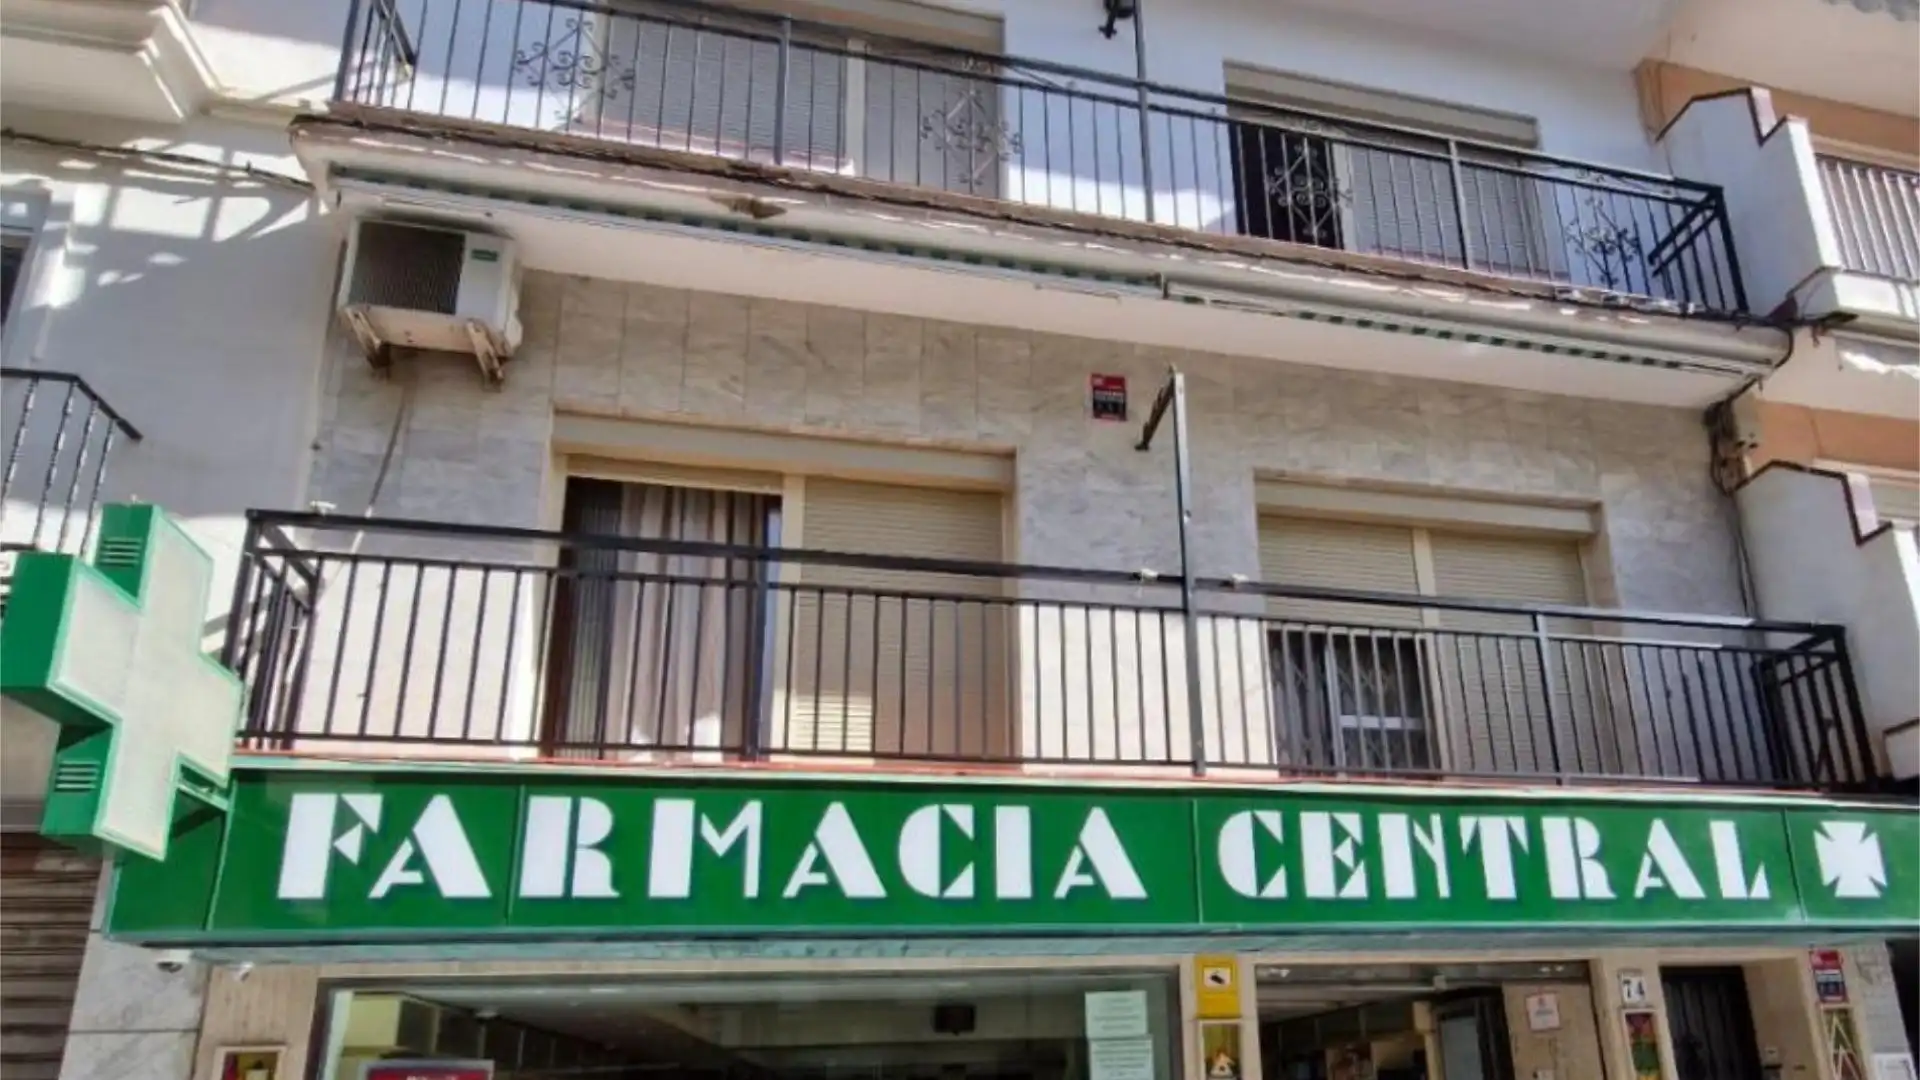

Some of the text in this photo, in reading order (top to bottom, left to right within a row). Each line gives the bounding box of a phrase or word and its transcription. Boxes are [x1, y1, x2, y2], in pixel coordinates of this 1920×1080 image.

[277, 793, 1771, 900] FARMACIA CENTRAL
[1622, 979, 1645, 998] 74
